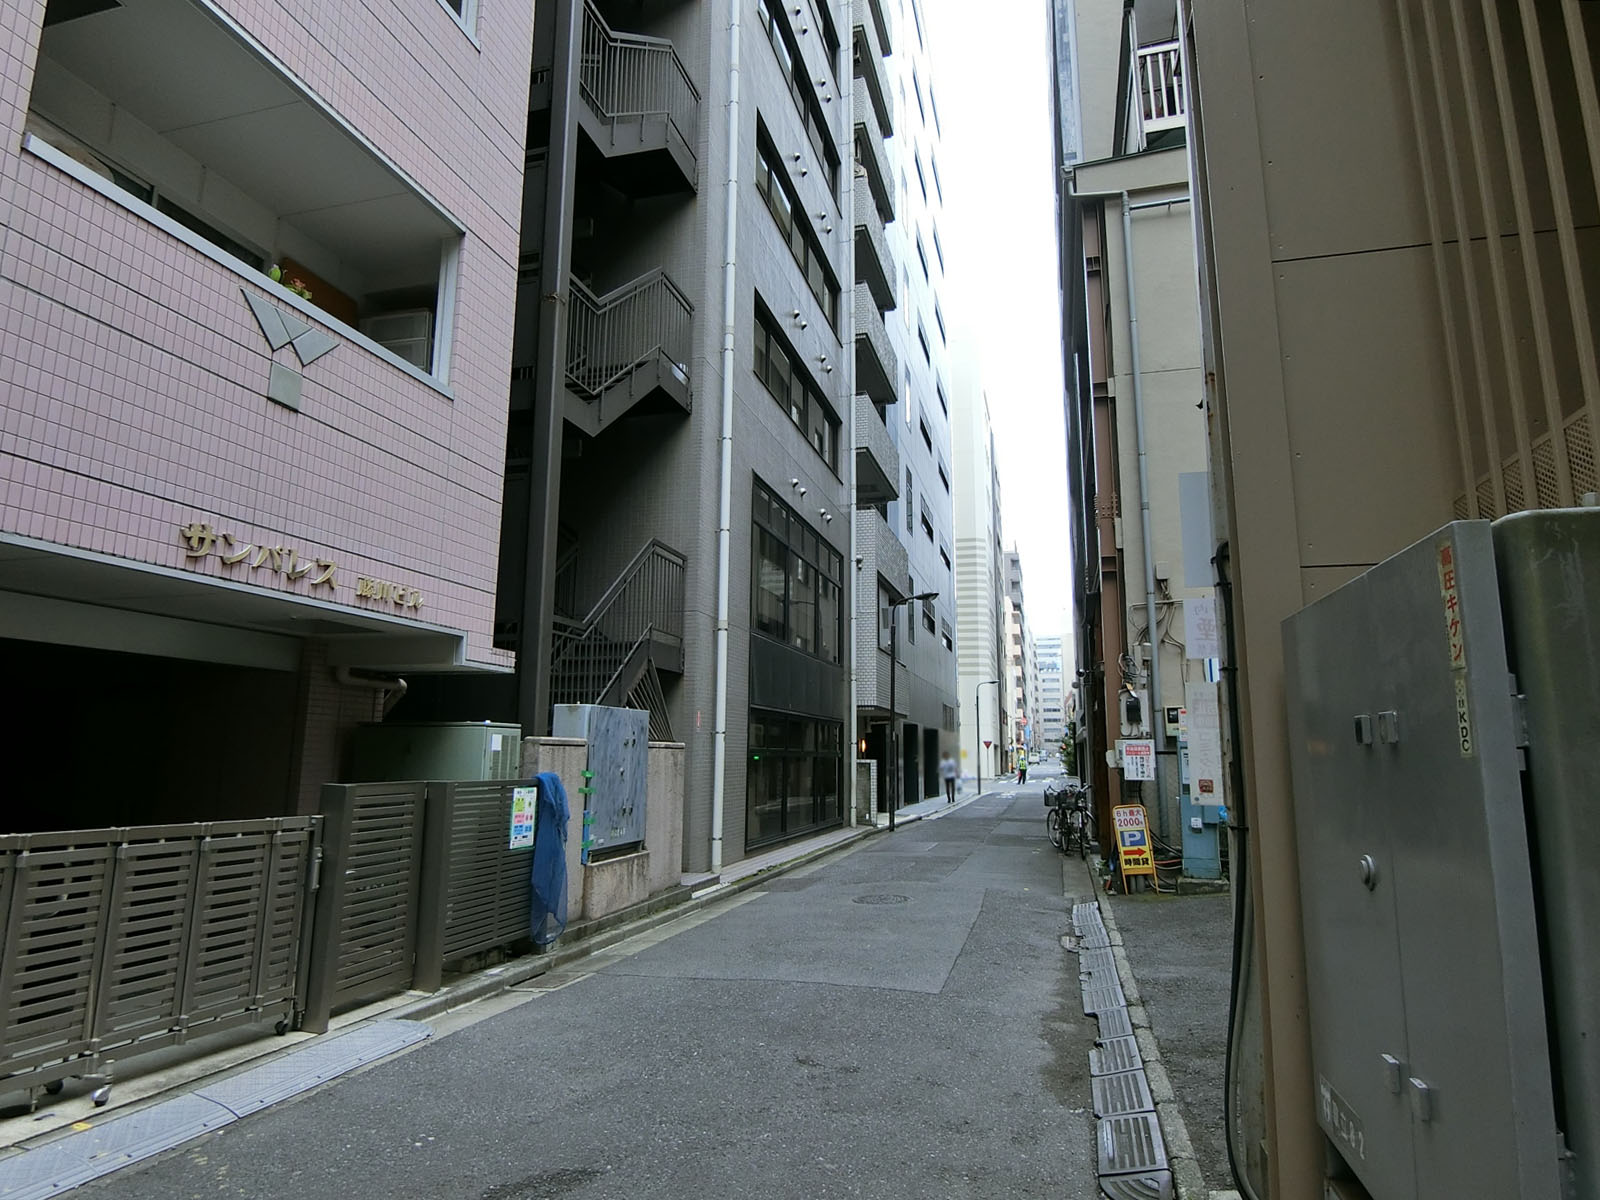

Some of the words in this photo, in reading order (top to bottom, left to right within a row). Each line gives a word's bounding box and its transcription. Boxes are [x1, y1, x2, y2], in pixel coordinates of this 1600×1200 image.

[181, 523, 337, 589] サンパレス
[1439, 546, 1464, 662] 高圧キケン
[1123, 831, 1141, 846] P
